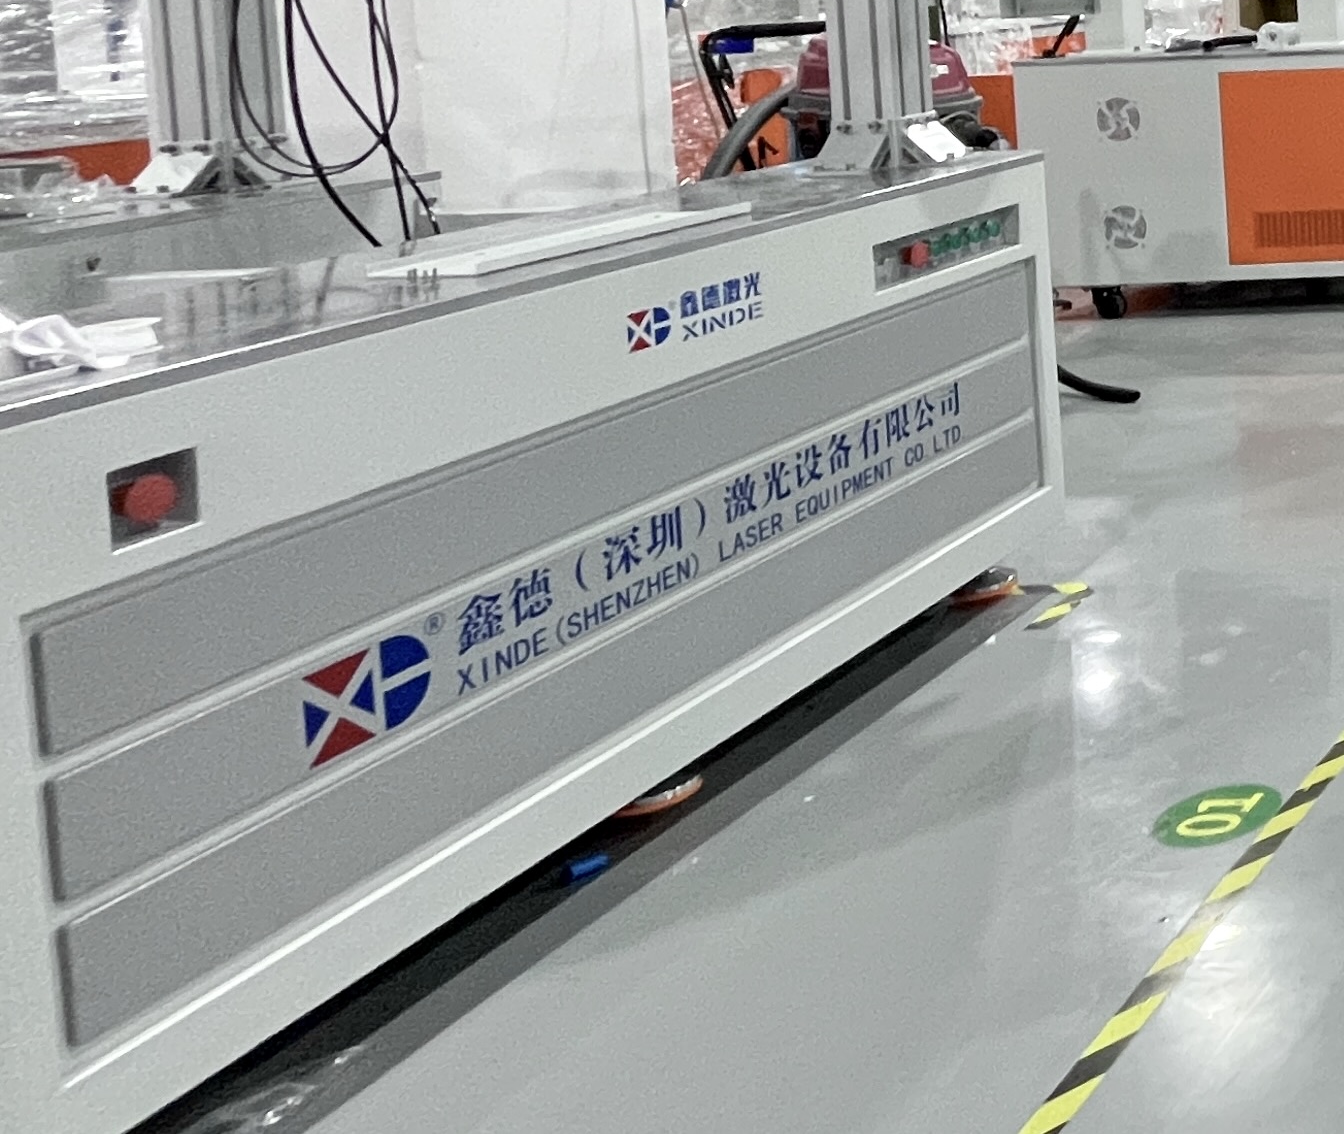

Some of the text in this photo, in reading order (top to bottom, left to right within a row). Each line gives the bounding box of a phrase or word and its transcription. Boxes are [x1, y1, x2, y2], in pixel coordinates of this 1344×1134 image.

[682, 301, 764, 343] XINDE
[718, 513, 783, 562] LASER
[795, 457, 894, 523] EQUIPMENT
[904, 443, 925, 467] CO
[933, 424, 961, 453] LTD
